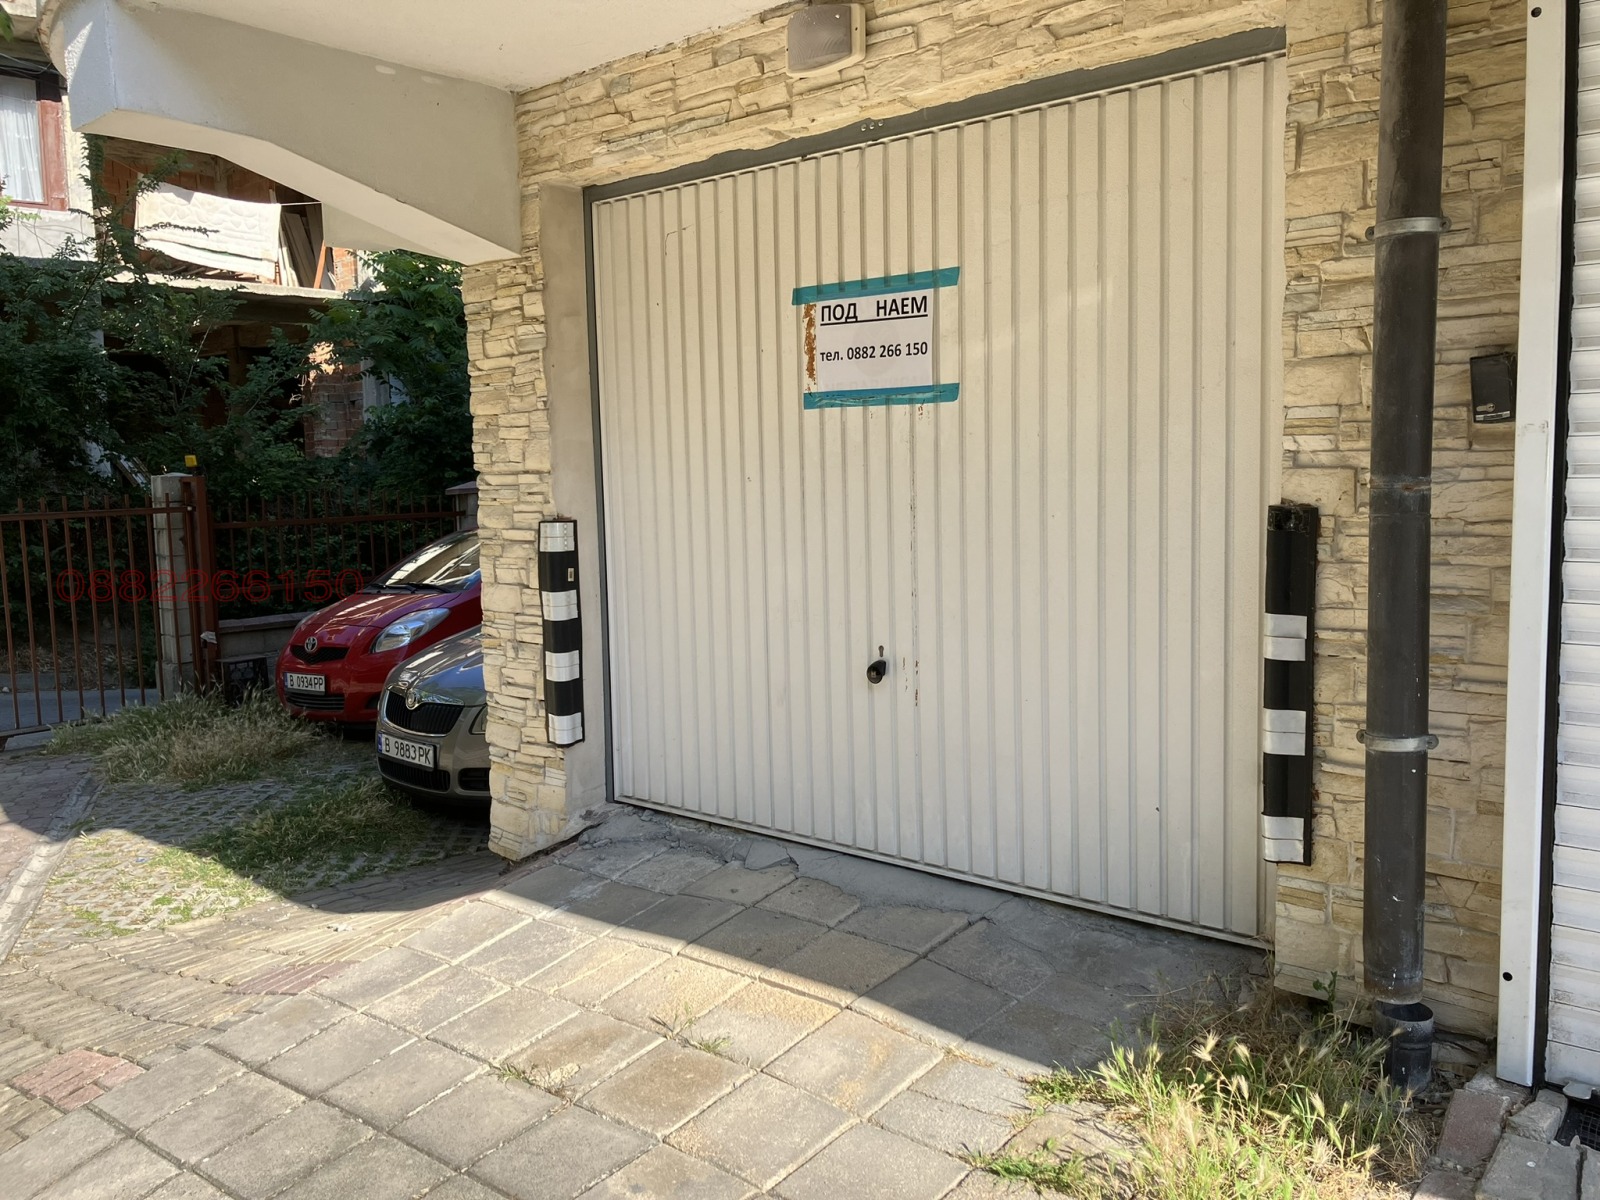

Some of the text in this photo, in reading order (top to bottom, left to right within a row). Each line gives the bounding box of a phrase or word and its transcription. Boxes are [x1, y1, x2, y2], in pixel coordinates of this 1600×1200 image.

[820, 295, 928, 324] ПОД НАЕМ
[820, 341, 928, 362] тел. 0882 266 150
